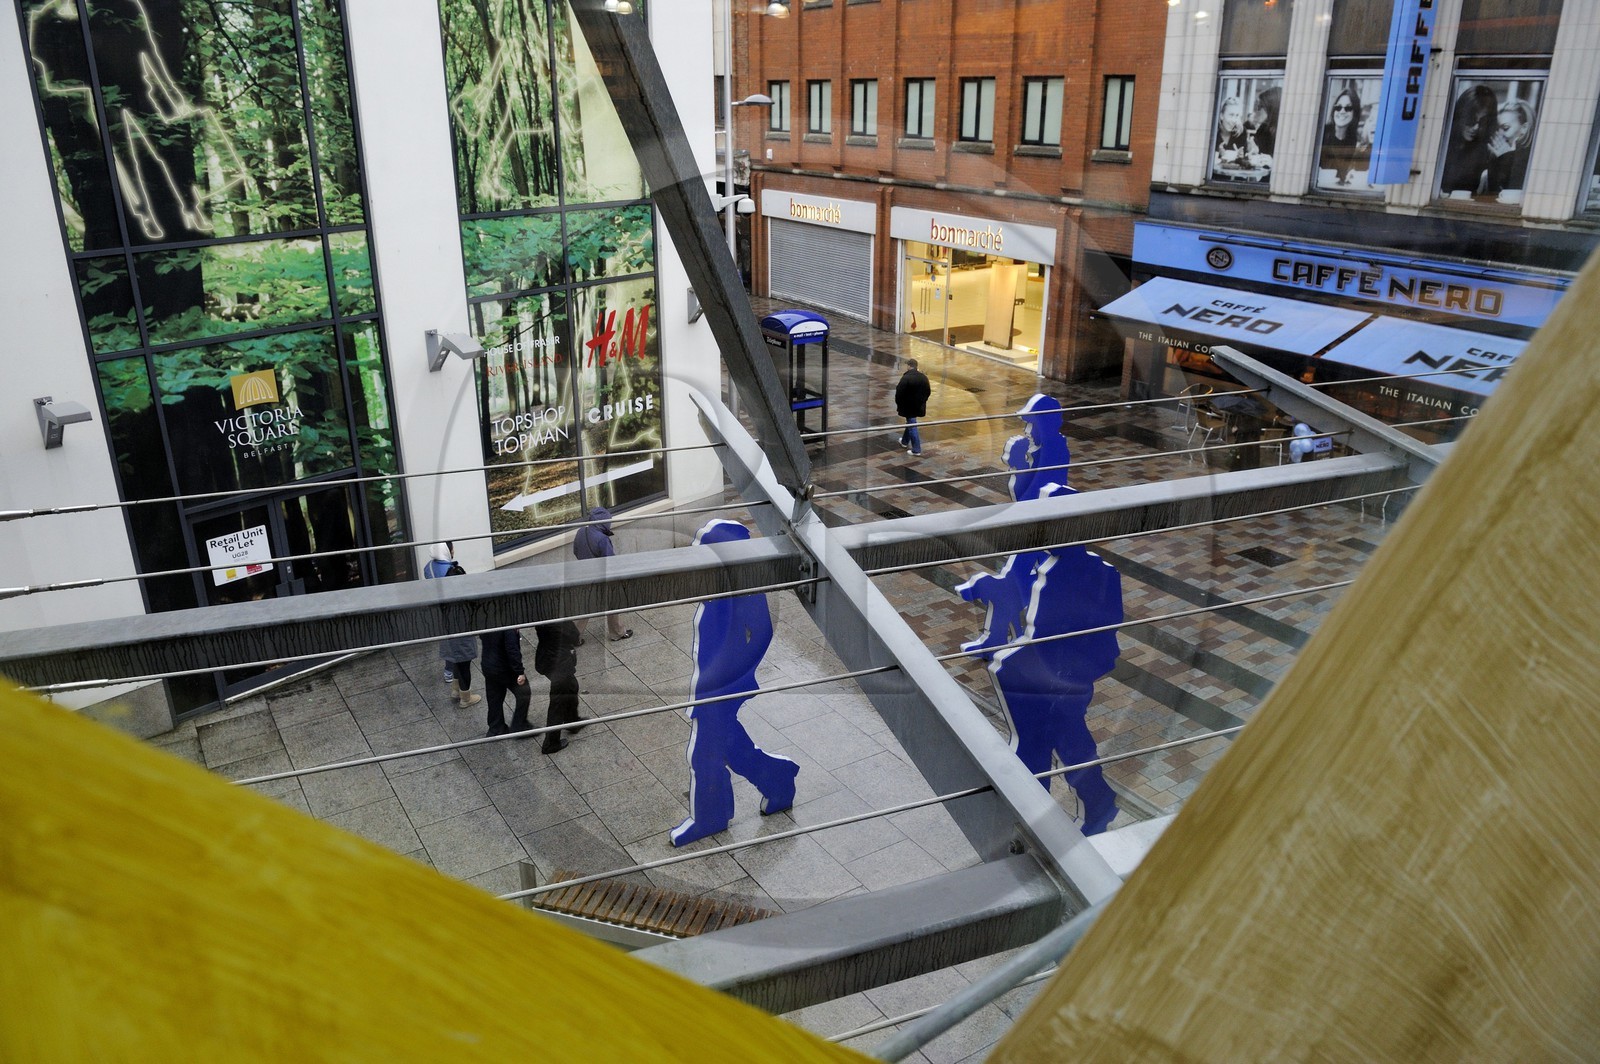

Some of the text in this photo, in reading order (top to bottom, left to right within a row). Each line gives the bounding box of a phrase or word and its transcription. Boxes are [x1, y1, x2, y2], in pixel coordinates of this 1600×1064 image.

[790, 198, 842, 224] bonmarché
[930, 217, 1004, 252] bonmarché
[1387, 274, 1504, 318] NERO
[1161, 303, 1284, 335] NERO
[585, 304, 652, 369] H&M
[1138, 331, 1153, 342] THE
[1157, 335, 1190, 349] ITALIAN
[483, 343, 514, 358] HOUSE
[588, 394, 654, 424] CRUISE
[1379, 385, 1400, 399] THE
[1406, 392, 1453, 411] ITALIAN
[213, 406, 305, 435] VICTORIA
[492, 405, 566, 436] TOPSHOP
[227, 422, 301, 449] SQUARE
[494, 424, 570, 457] TOPMAN
[243, 443, 289, 459] BELFAST
[209, 528, 264, 549] Retail Unit
[222, 539, 254, 553] To Let
[231, 550, 249, 559] UG28
